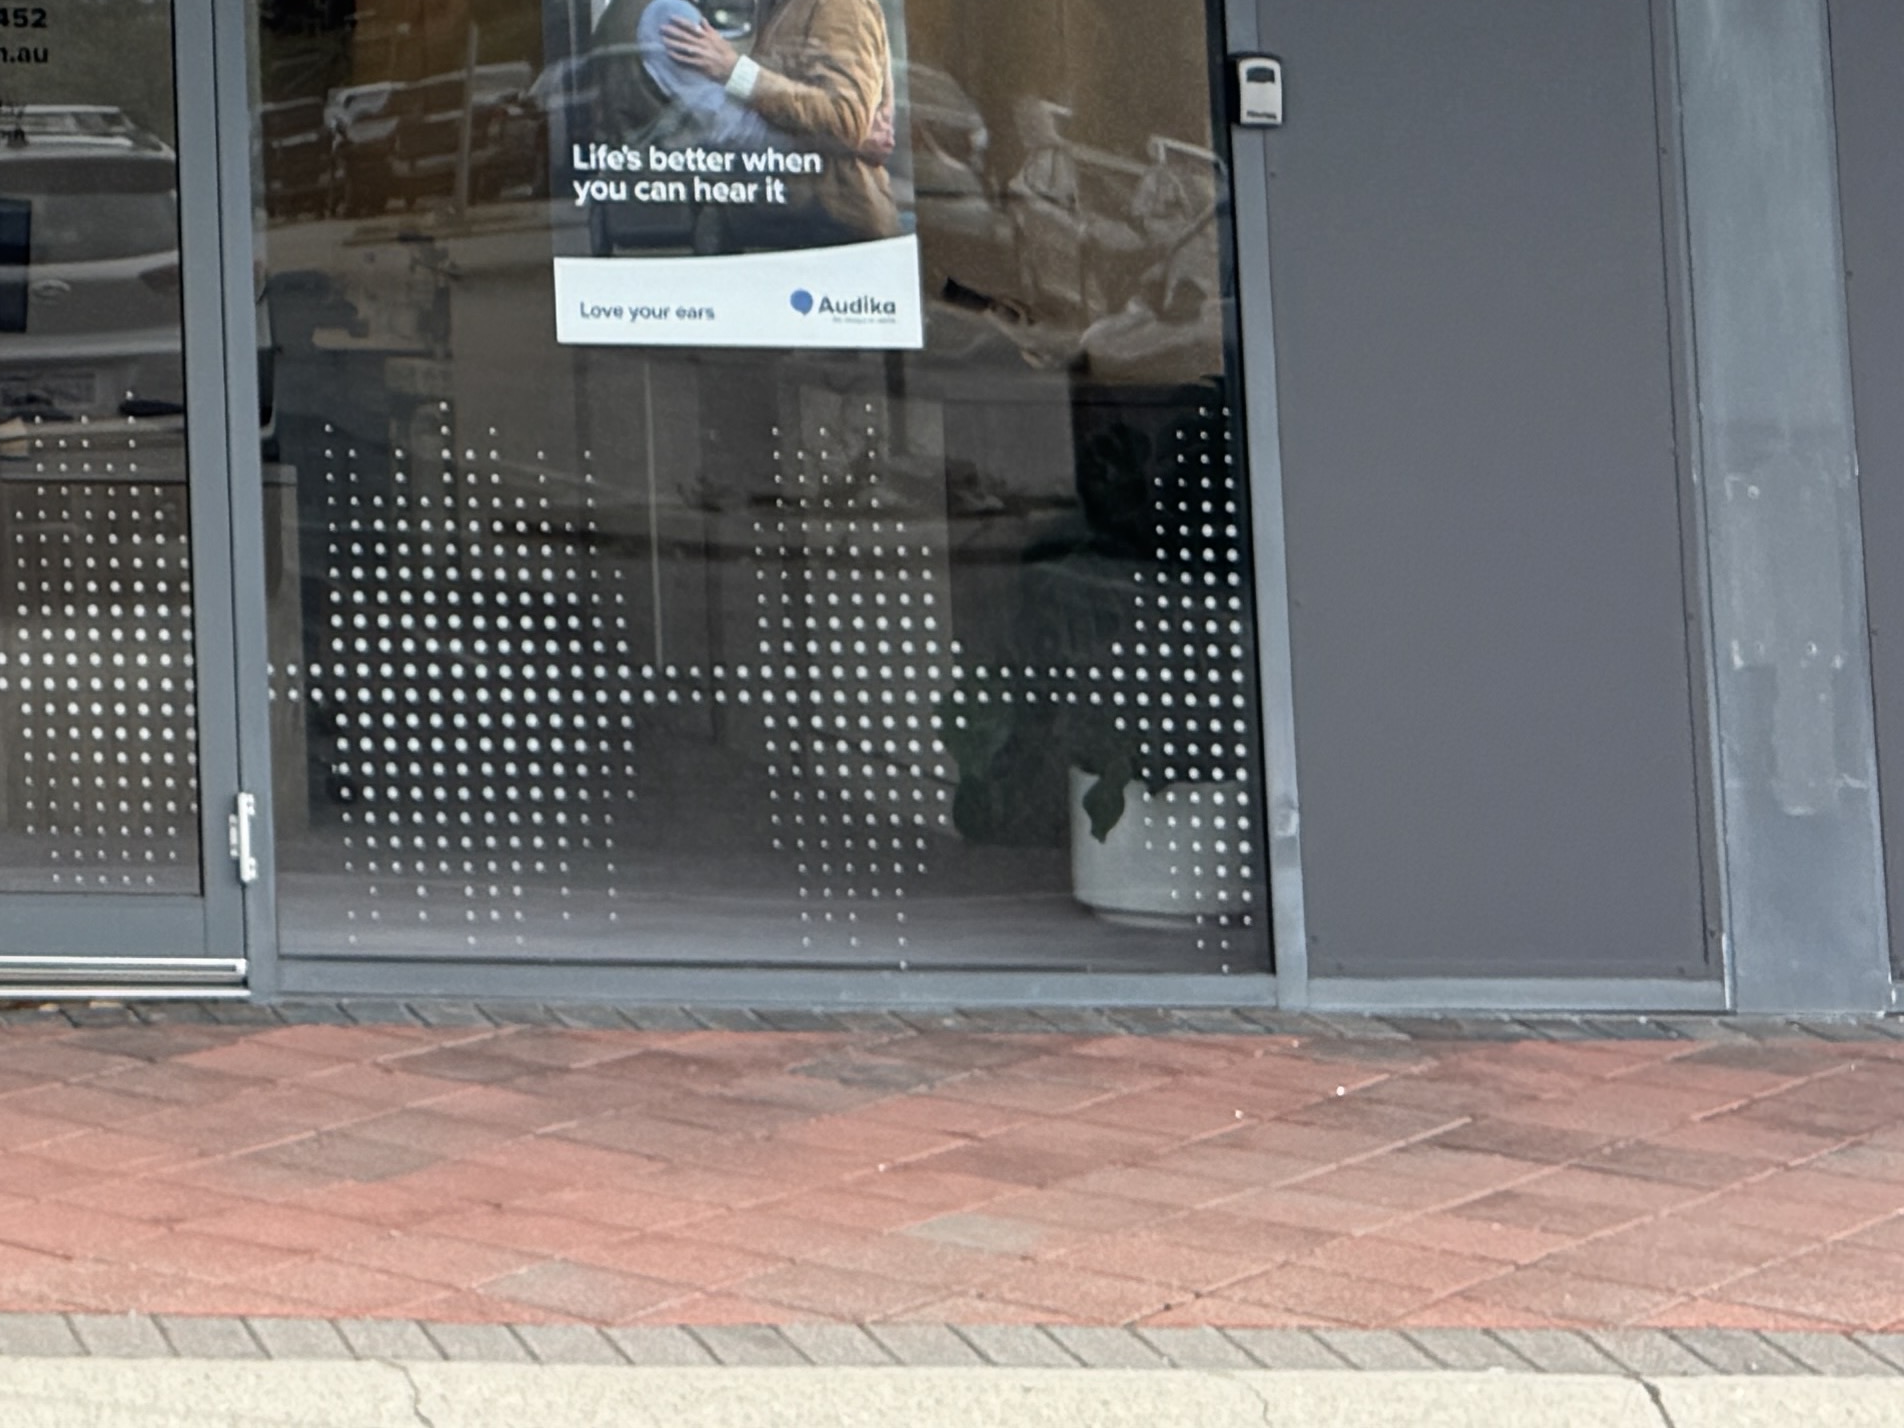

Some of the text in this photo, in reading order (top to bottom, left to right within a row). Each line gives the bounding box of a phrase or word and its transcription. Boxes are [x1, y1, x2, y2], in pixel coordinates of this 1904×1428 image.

[572, 144, 822, 174] Life's better when
[572, 175, 786, 207] you can hear it
[580, 301, 715, 323] Love your ears
[818, 294, 896, 315] Audika
